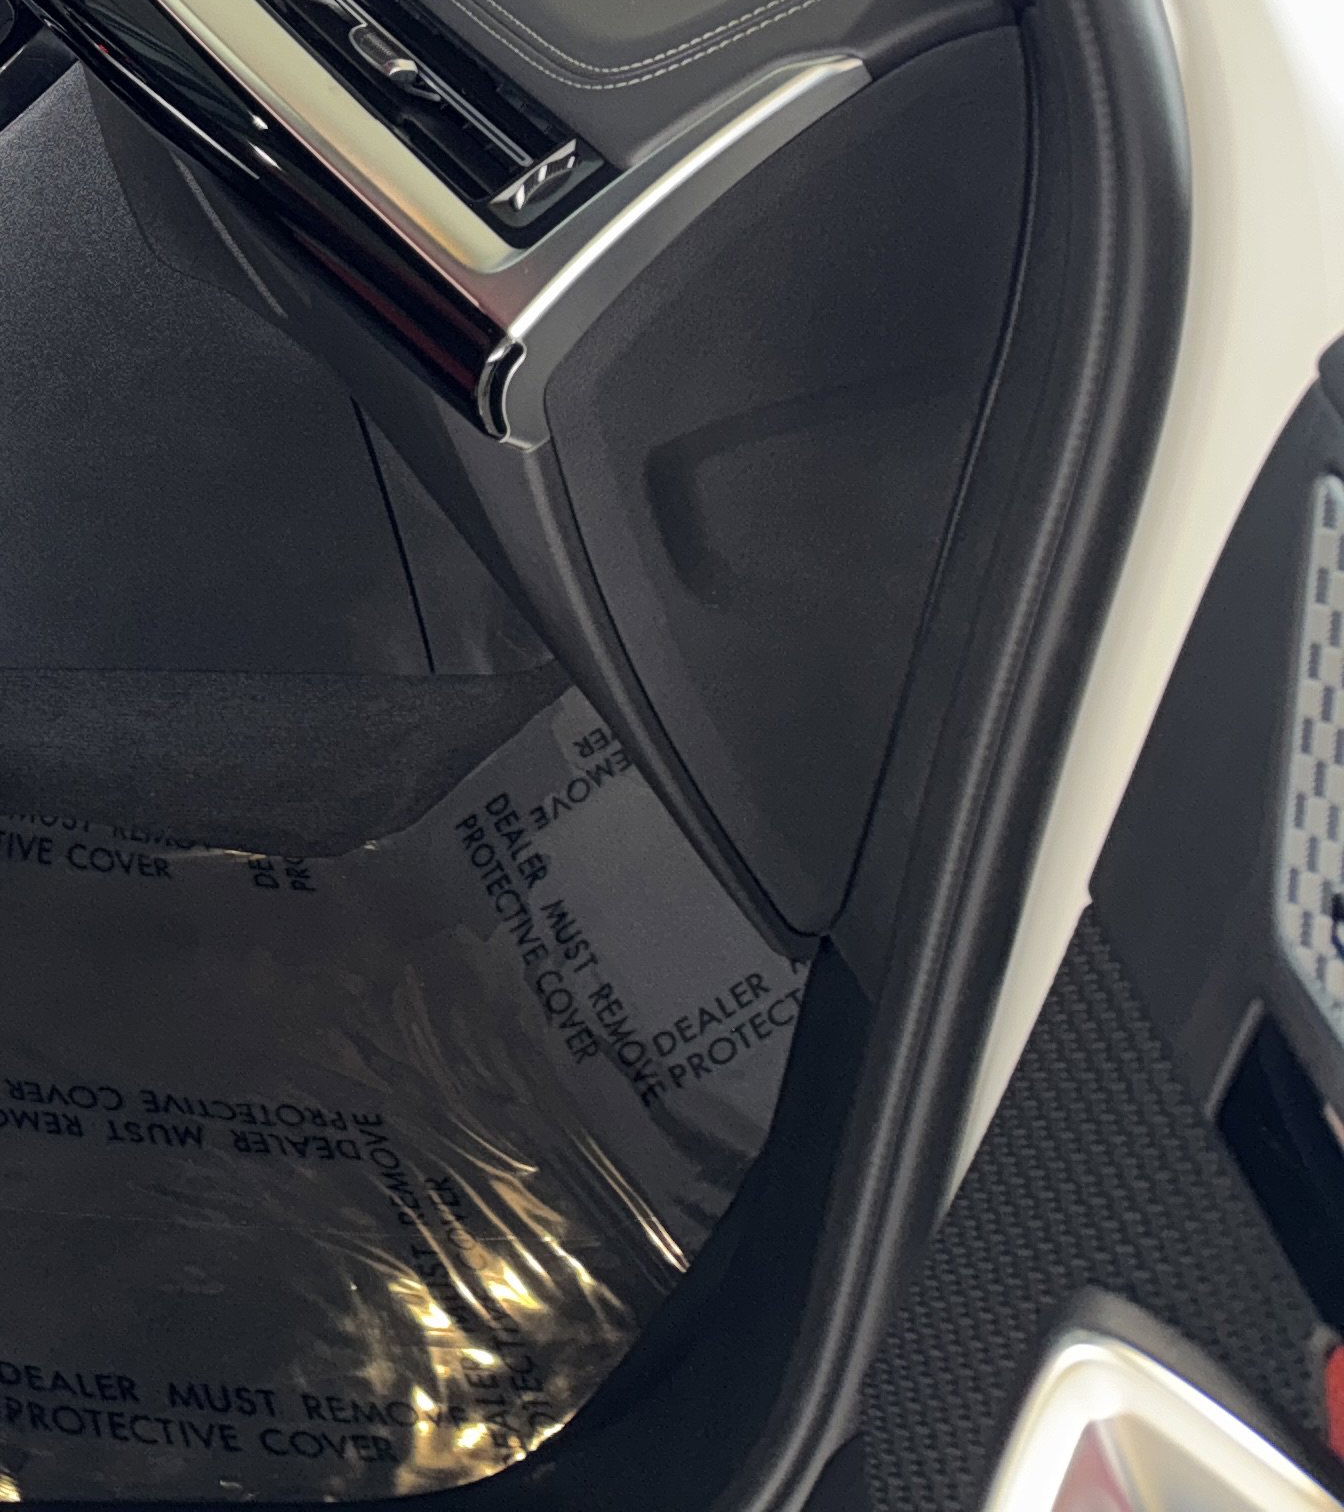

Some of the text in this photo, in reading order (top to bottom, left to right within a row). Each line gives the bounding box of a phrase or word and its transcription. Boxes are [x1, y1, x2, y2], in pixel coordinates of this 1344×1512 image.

[66, 843, 173, 881] COVER
[455, 813, 600, 1065] PROTECTIVE COVER
[485, 793, 667, 1108] DEALER MUST REMOVE
[652, 973, 772, 1057] DEALER
[5, 1078, 349, 1132] PROTECTIVE COVER
[107, 1119, 204, 1148] MUST
[231, 1128, 362, 1163] DEALER
[352, 1111, 426, 1227] REMOVE
[168, 1381, 278, 1419] MUST
[5, 1397, 400, 1465] PROTECTIVE COVER
